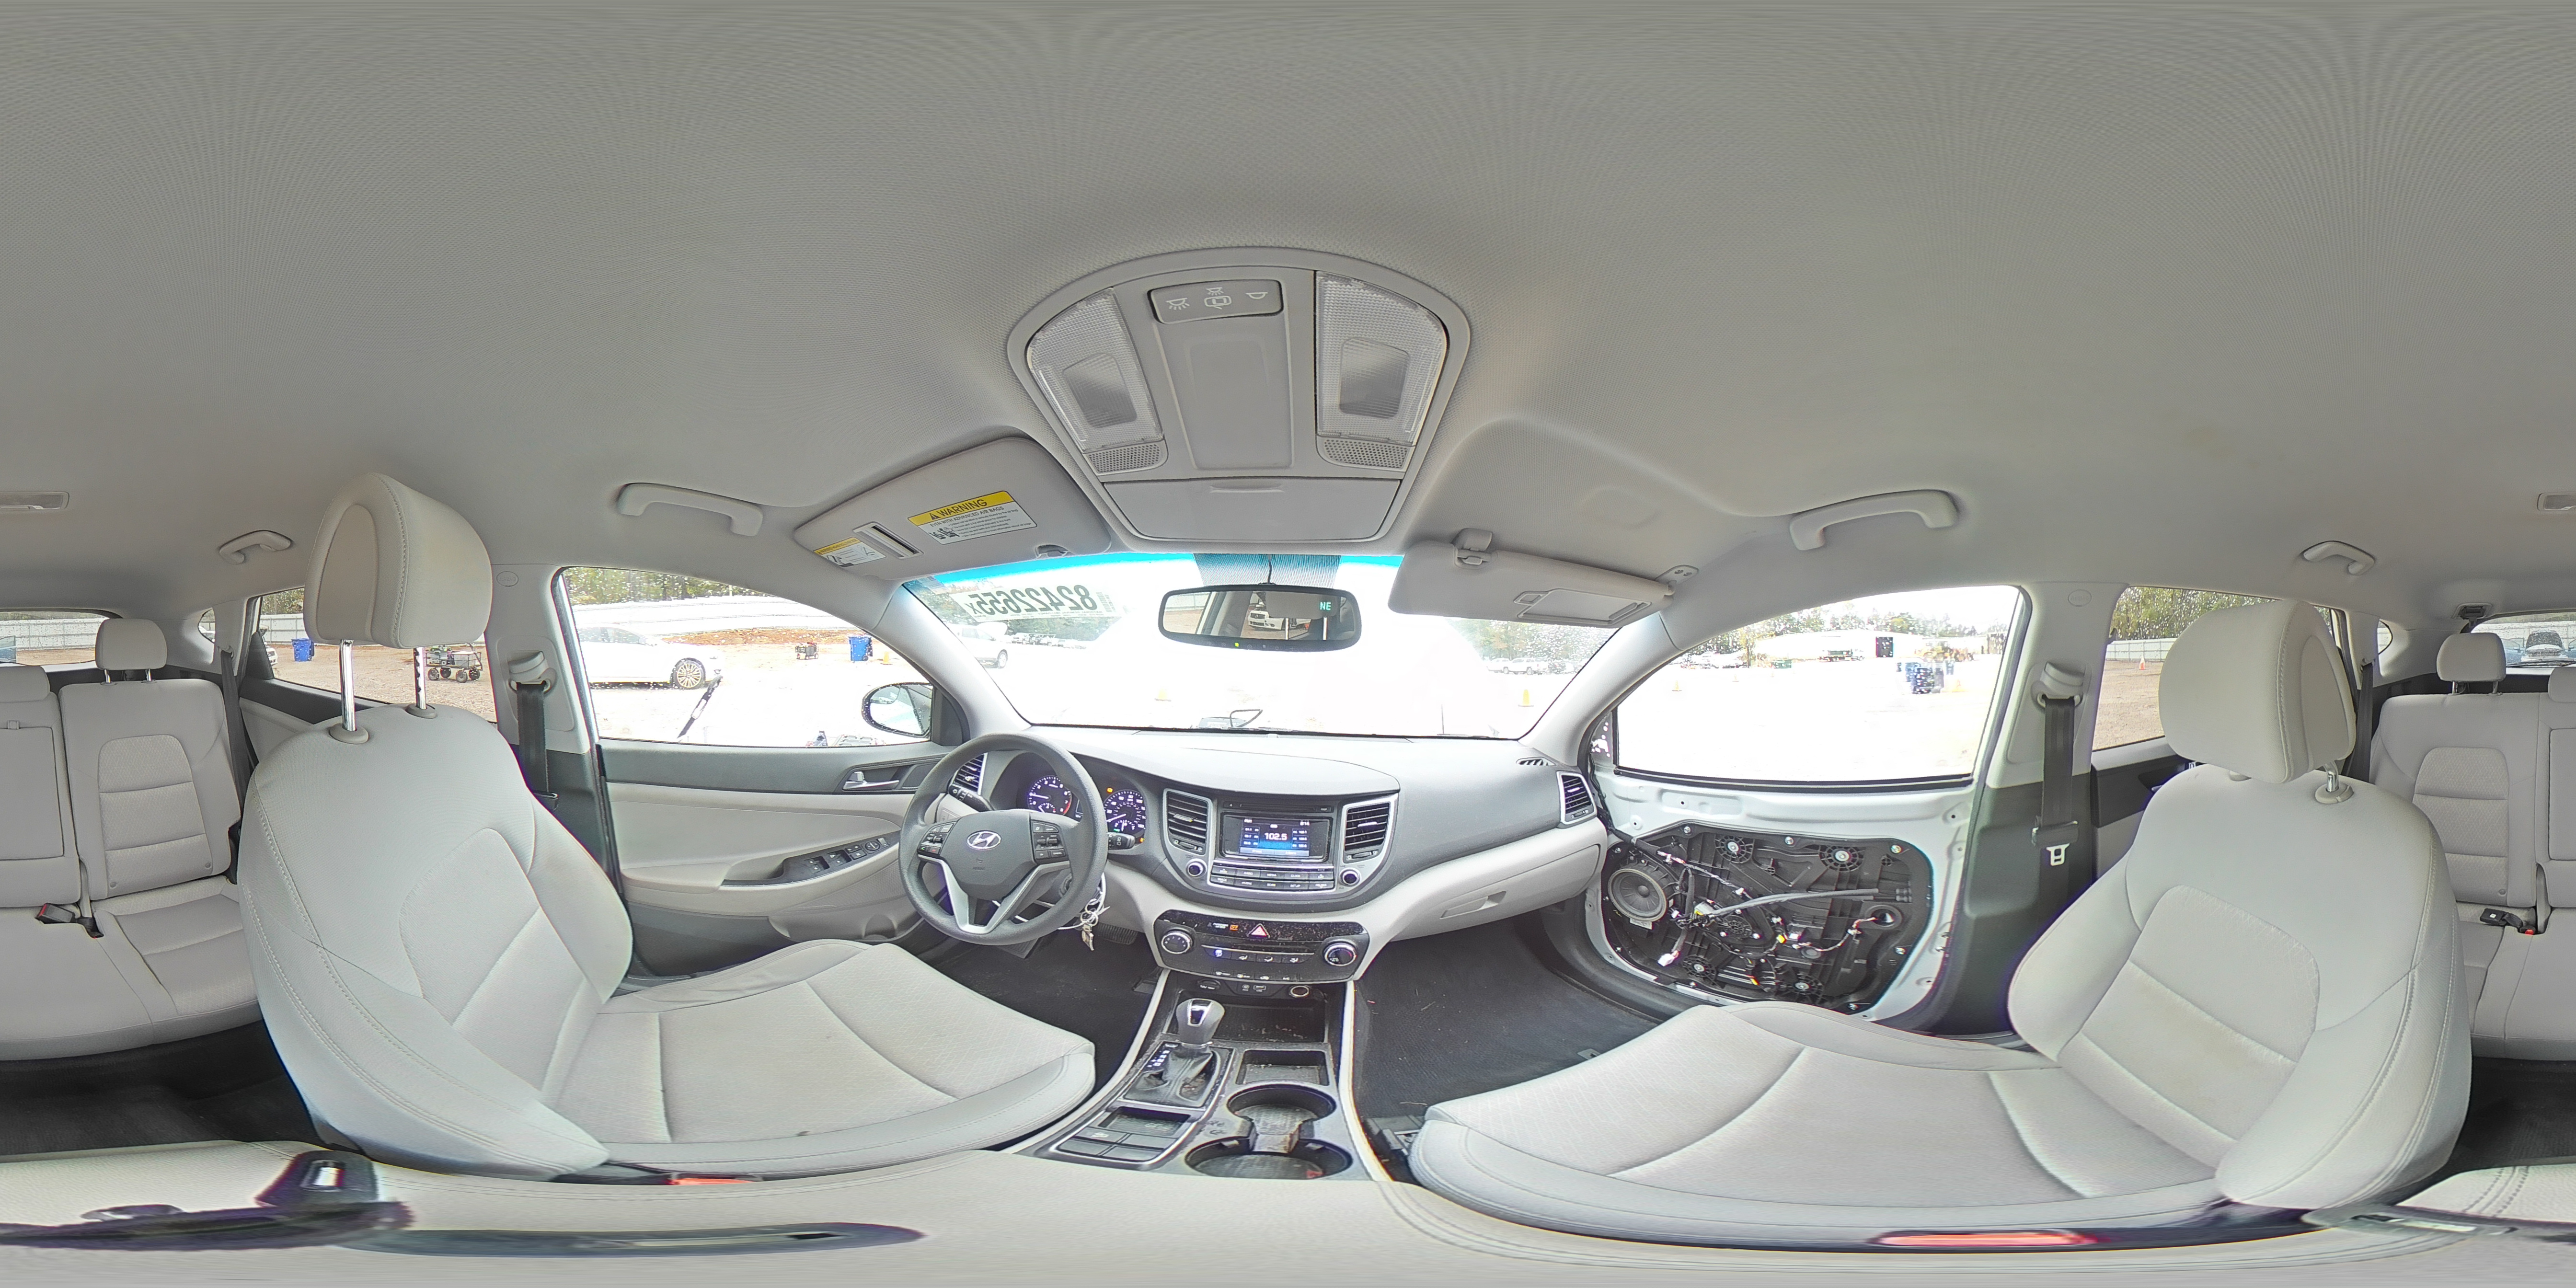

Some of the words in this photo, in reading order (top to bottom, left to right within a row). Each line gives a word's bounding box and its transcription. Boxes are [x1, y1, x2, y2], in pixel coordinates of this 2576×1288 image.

[936, 499, 987, 517] WARNING
[953, 512, 979, 521] ADVANCED
[1320, 601, 1332, 610] NE
[1264, 832, 1288, 841] 102.5
